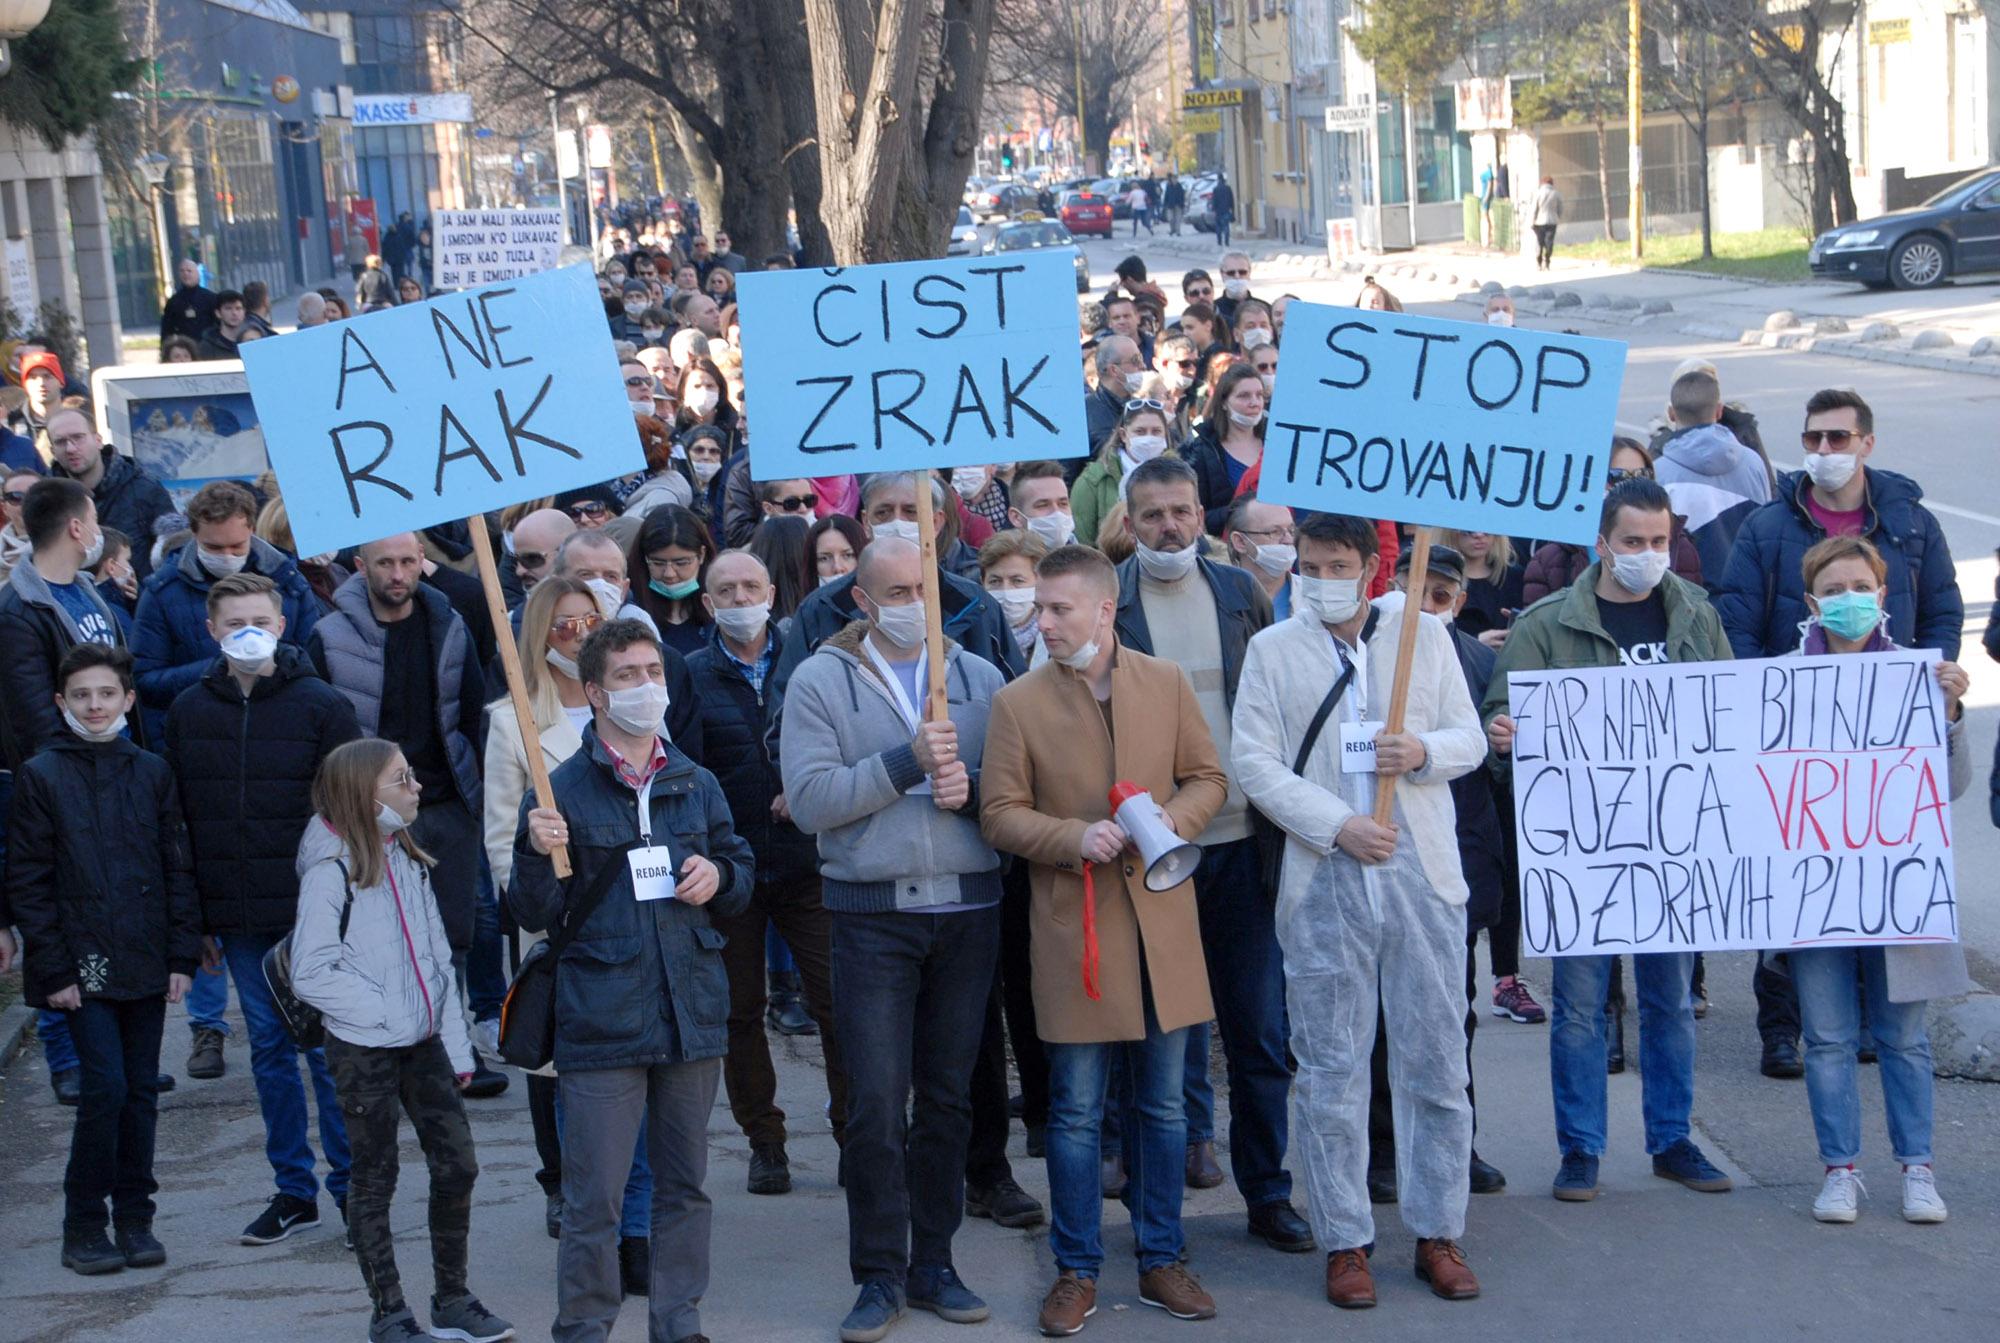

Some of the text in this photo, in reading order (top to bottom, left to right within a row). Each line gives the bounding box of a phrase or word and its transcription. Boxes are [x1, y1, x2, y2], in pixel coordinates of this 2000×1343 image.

[1185, 91, 1238, 106] NOTAR
[1330, 108, 1370, 121] ADVOKAT
[442, 213, 560, 227] JA SAM MALI SKAKAVAC
[443, 250, 535, 265] A TEK KAO TUZLA
[448, 233, 485, 246] SMRDIM
[512, 231, 558, 244] LUKAVAC
[468, 271, 476, 283] JE
[813, 265, 1026, 347] ČIST
[335, 288, 534, 410] A NE
[1319, 321, 1591, 414] STOP
[329, 374, 584, 518] RAK
[796, 355, 1060, 455] ZRAK
[1275, 421, 1594, 512] TROVANJU!
[1510, 661, 1941, 762] ZAR NAM JE BITNIJA
[1521, 747, 1950, 857] GUZICA VRUĆA
[636, 866, 668, 879] REDAR
[1524, 843, 1956, 953] OD ZDRAVIH PLUĆA
